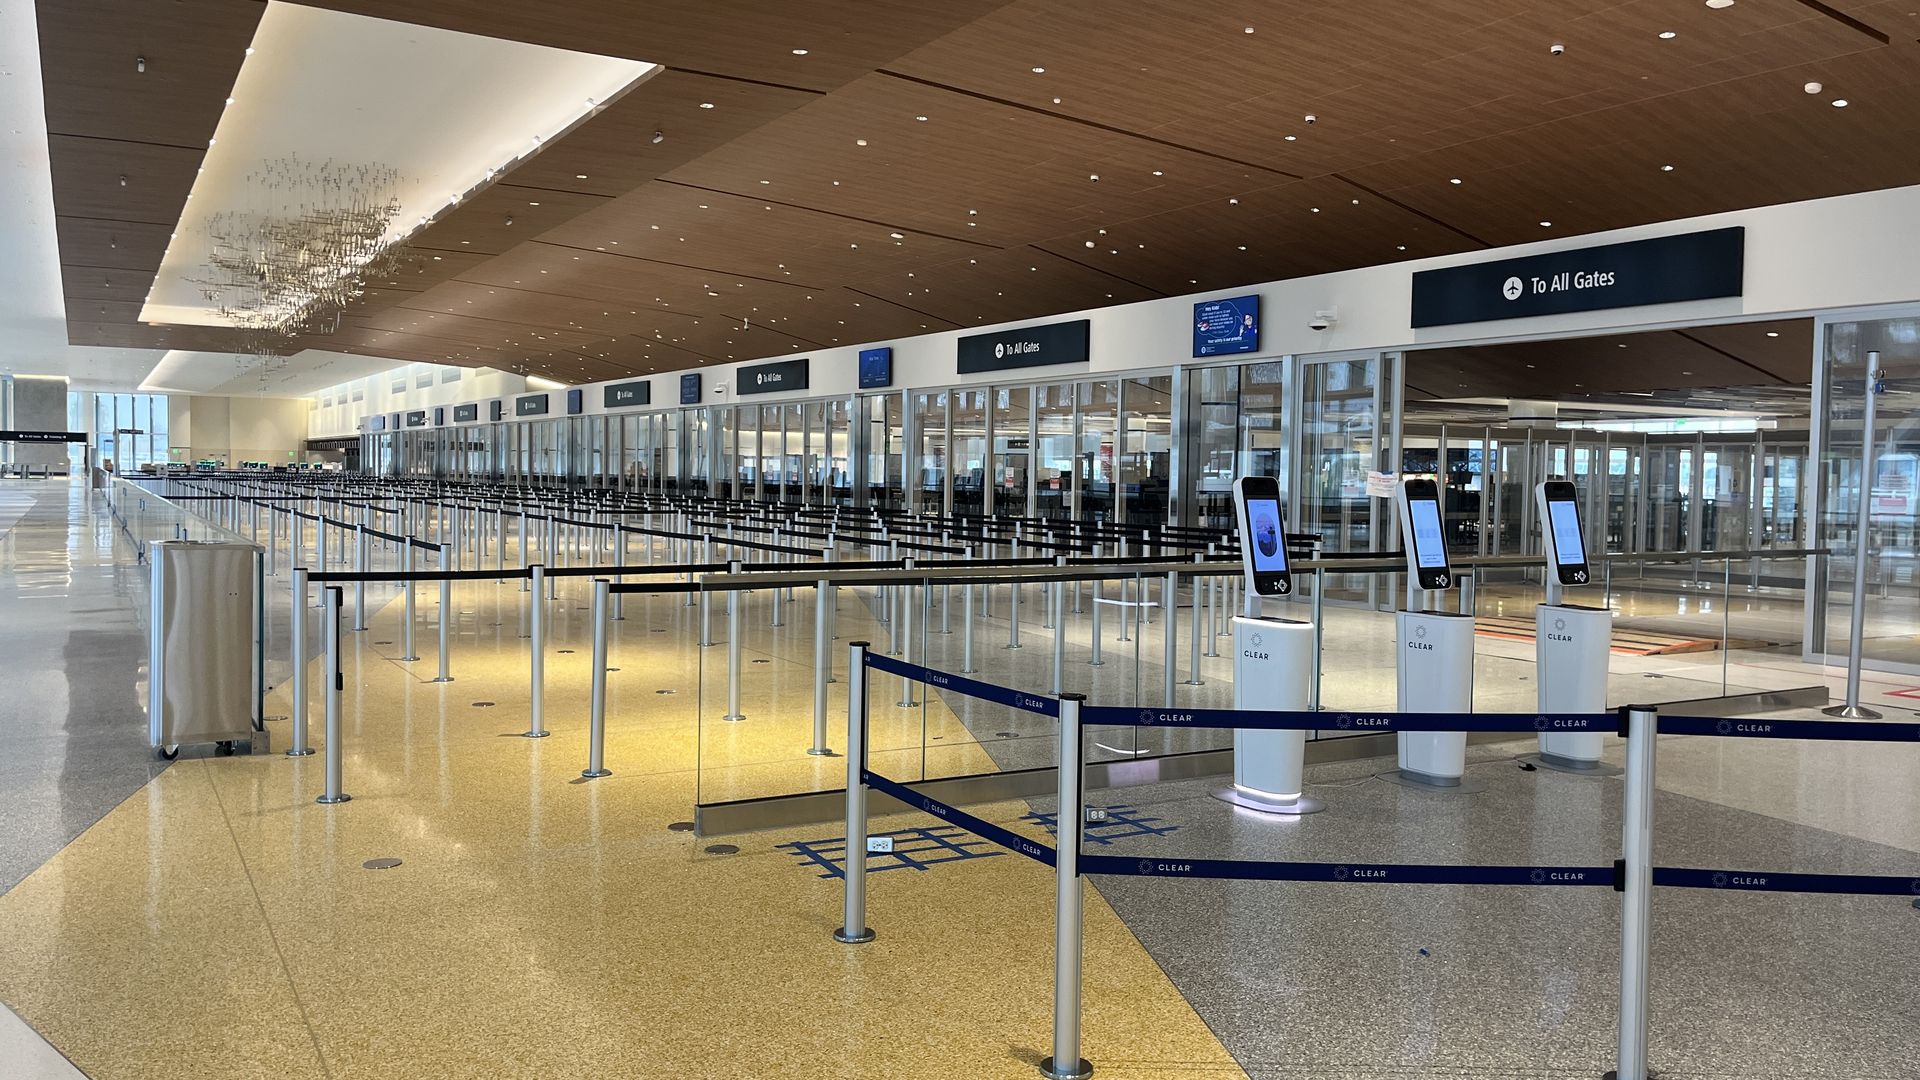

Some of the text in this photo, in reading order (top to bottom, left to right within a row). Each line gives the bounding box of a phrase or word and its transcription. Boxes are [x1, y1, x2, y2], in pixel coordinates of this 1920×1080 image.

[1530, 271, 1614, 294] To All Gates
[1006, 341, 1039, 354] To All Gates
[1548, 634, 1572, 642] CLEAR
[1408, 642, 1432, 651] CLEAR
[1244, 650, 1268, 660] CLEAR
[933, 674, 948, 685] CLEAR
[1025, 698, 1043, 709] CLEAR
[1160, 714, 1192, 722] CLEAR
[1554, 720, 1587, 728] CLEAR
[1736, 724, 1770, 732] CLEAR
[931, 804, 947, 816] CLEAR
[1022, 843, 1041, 856] CLEAR
[1158, 864, 1190, 872] CLEAR
[1354, 870, 1386, 878] CLEAR
[1732, 876, 1766, 885] CLEAR
